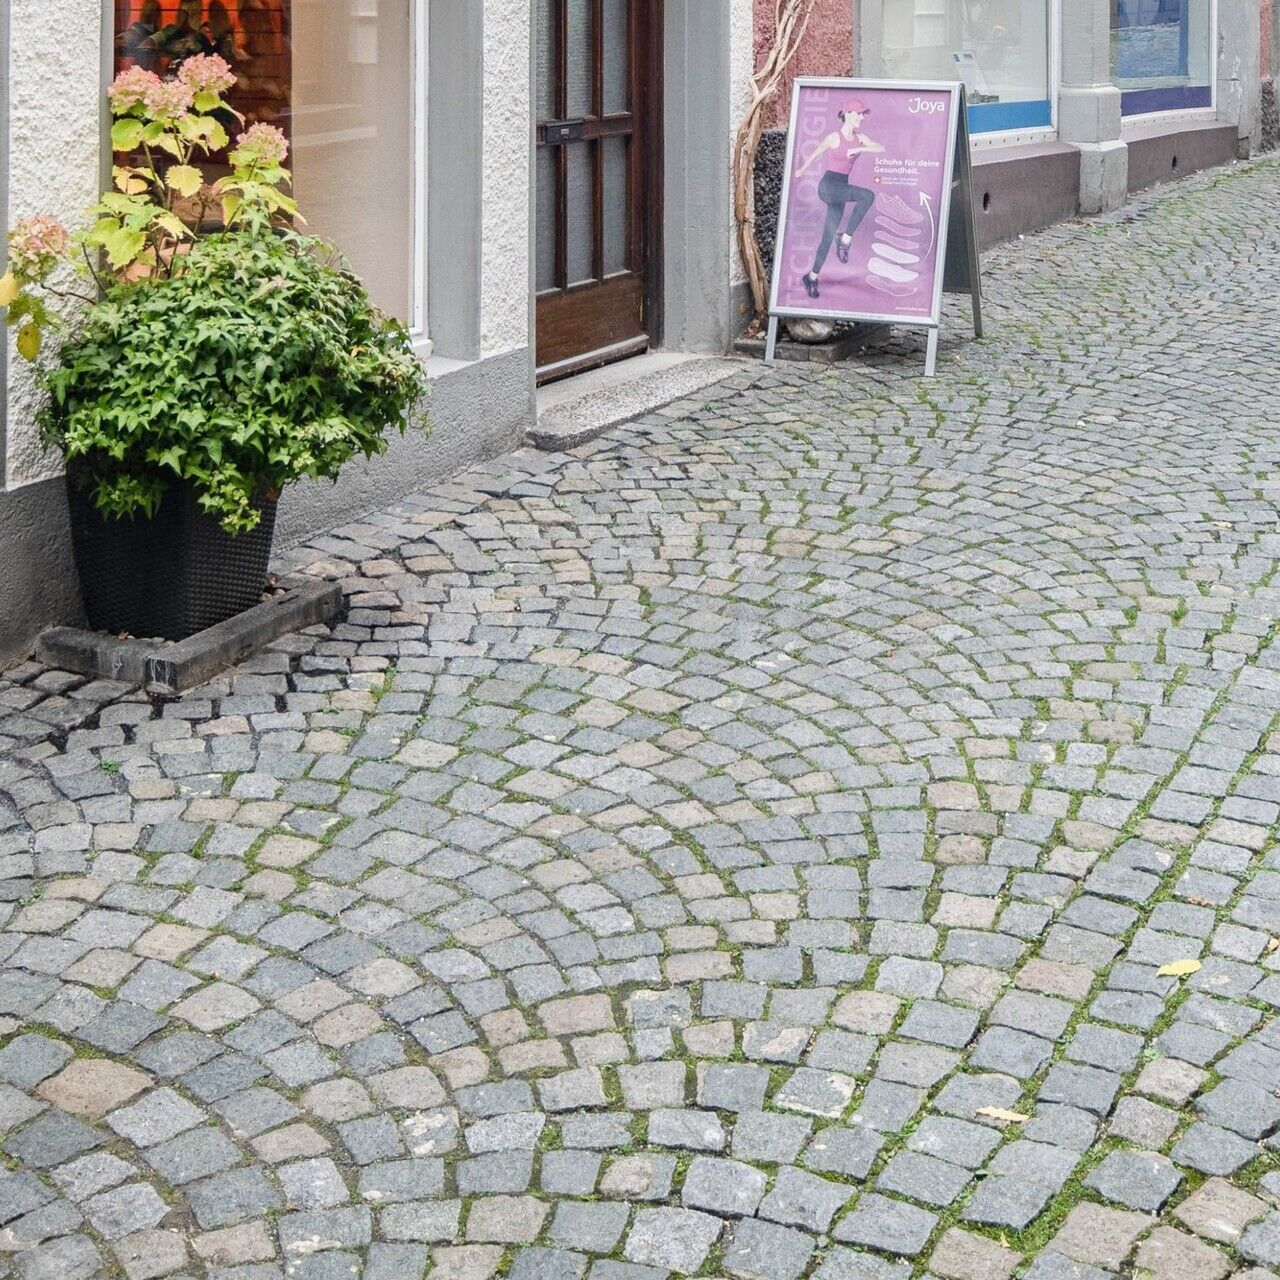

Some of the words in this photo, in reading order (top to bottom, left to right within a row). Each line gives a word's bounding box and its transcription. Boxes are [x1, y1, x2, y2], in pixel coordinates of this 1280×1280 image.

[908, 98, 945, 114] Joya
[874, 158, 902, 167] Schuhe
[904, 158, 916, 168] für
[918, 159, 940, 168] deine
